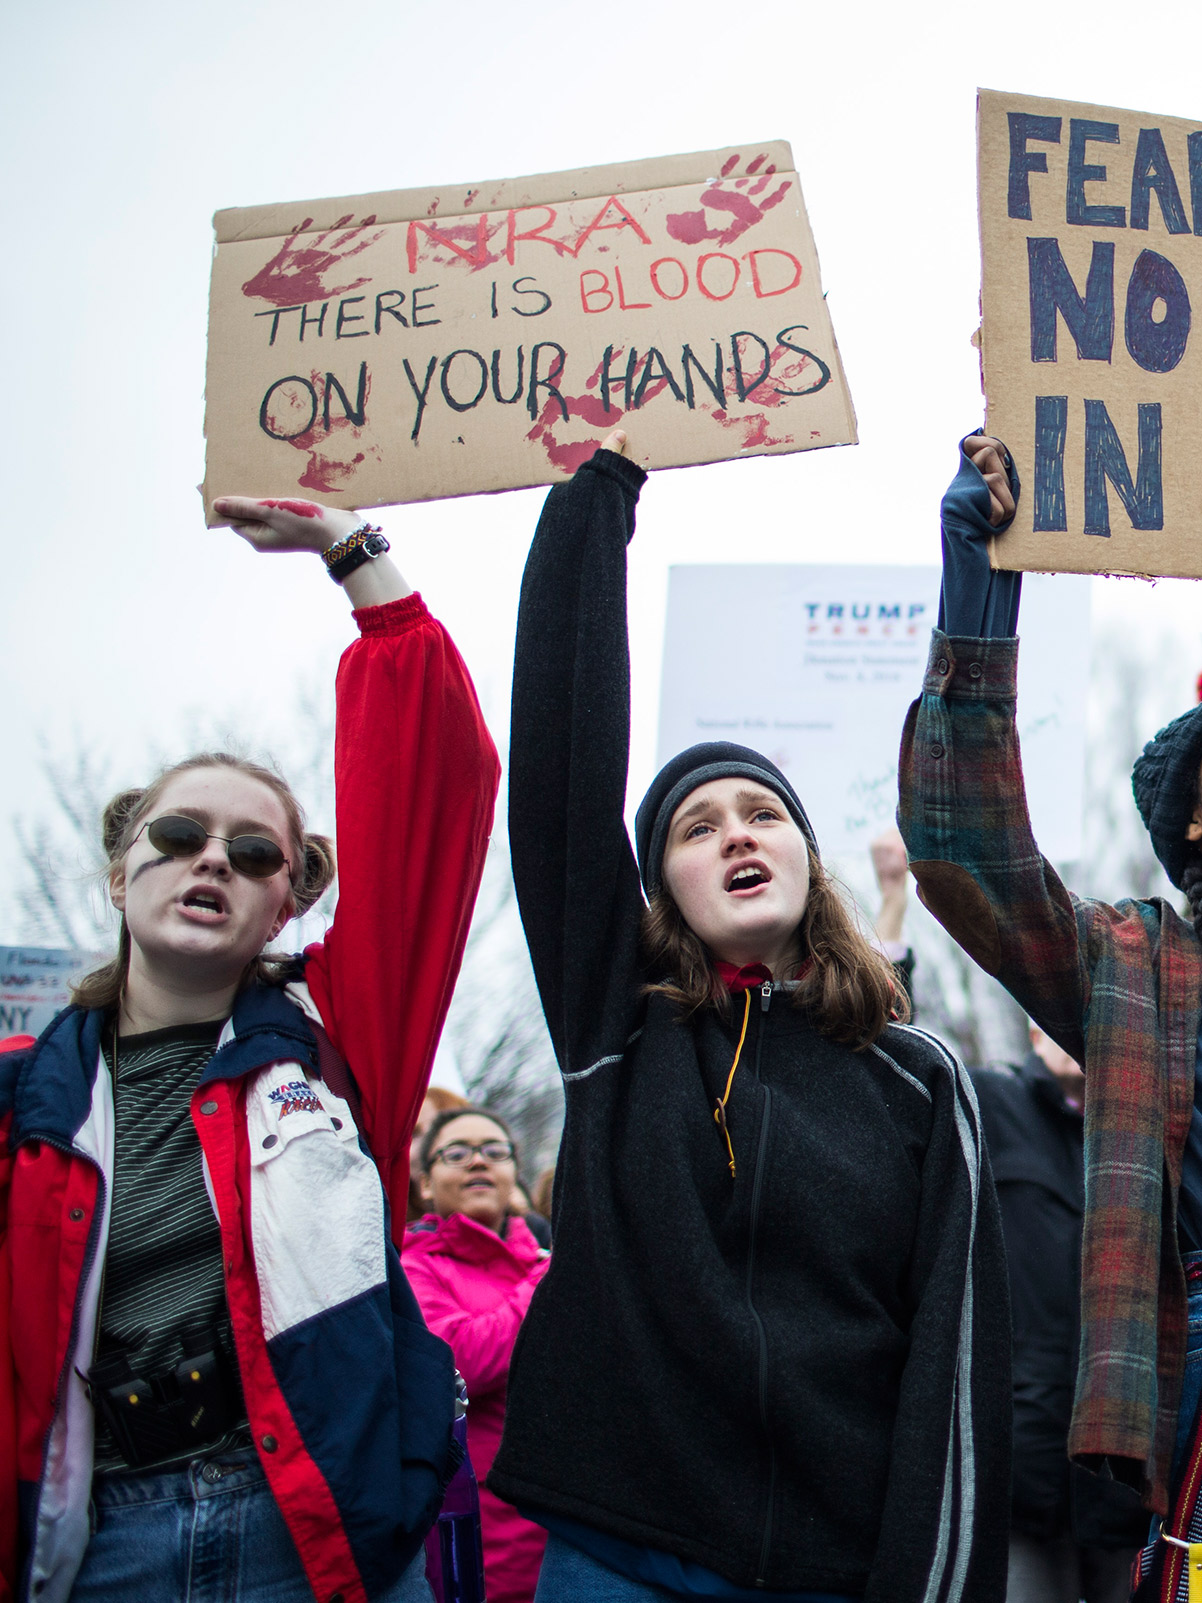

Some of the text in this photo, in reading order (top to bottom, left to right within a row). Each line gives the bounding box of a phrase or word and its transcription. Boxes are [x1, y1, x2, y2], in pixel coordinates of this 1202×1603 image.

[405, 195, 652, 274] NRA
[254, 249, 802, 345] THERE IS BLOOD
[1027, 237, 1191, 374] NO
[260, 325, 831, 446] ON YOUR HANDS
[1032, 396, 1164, 538] IN
[804, 603, 925, 619] TRUMP
